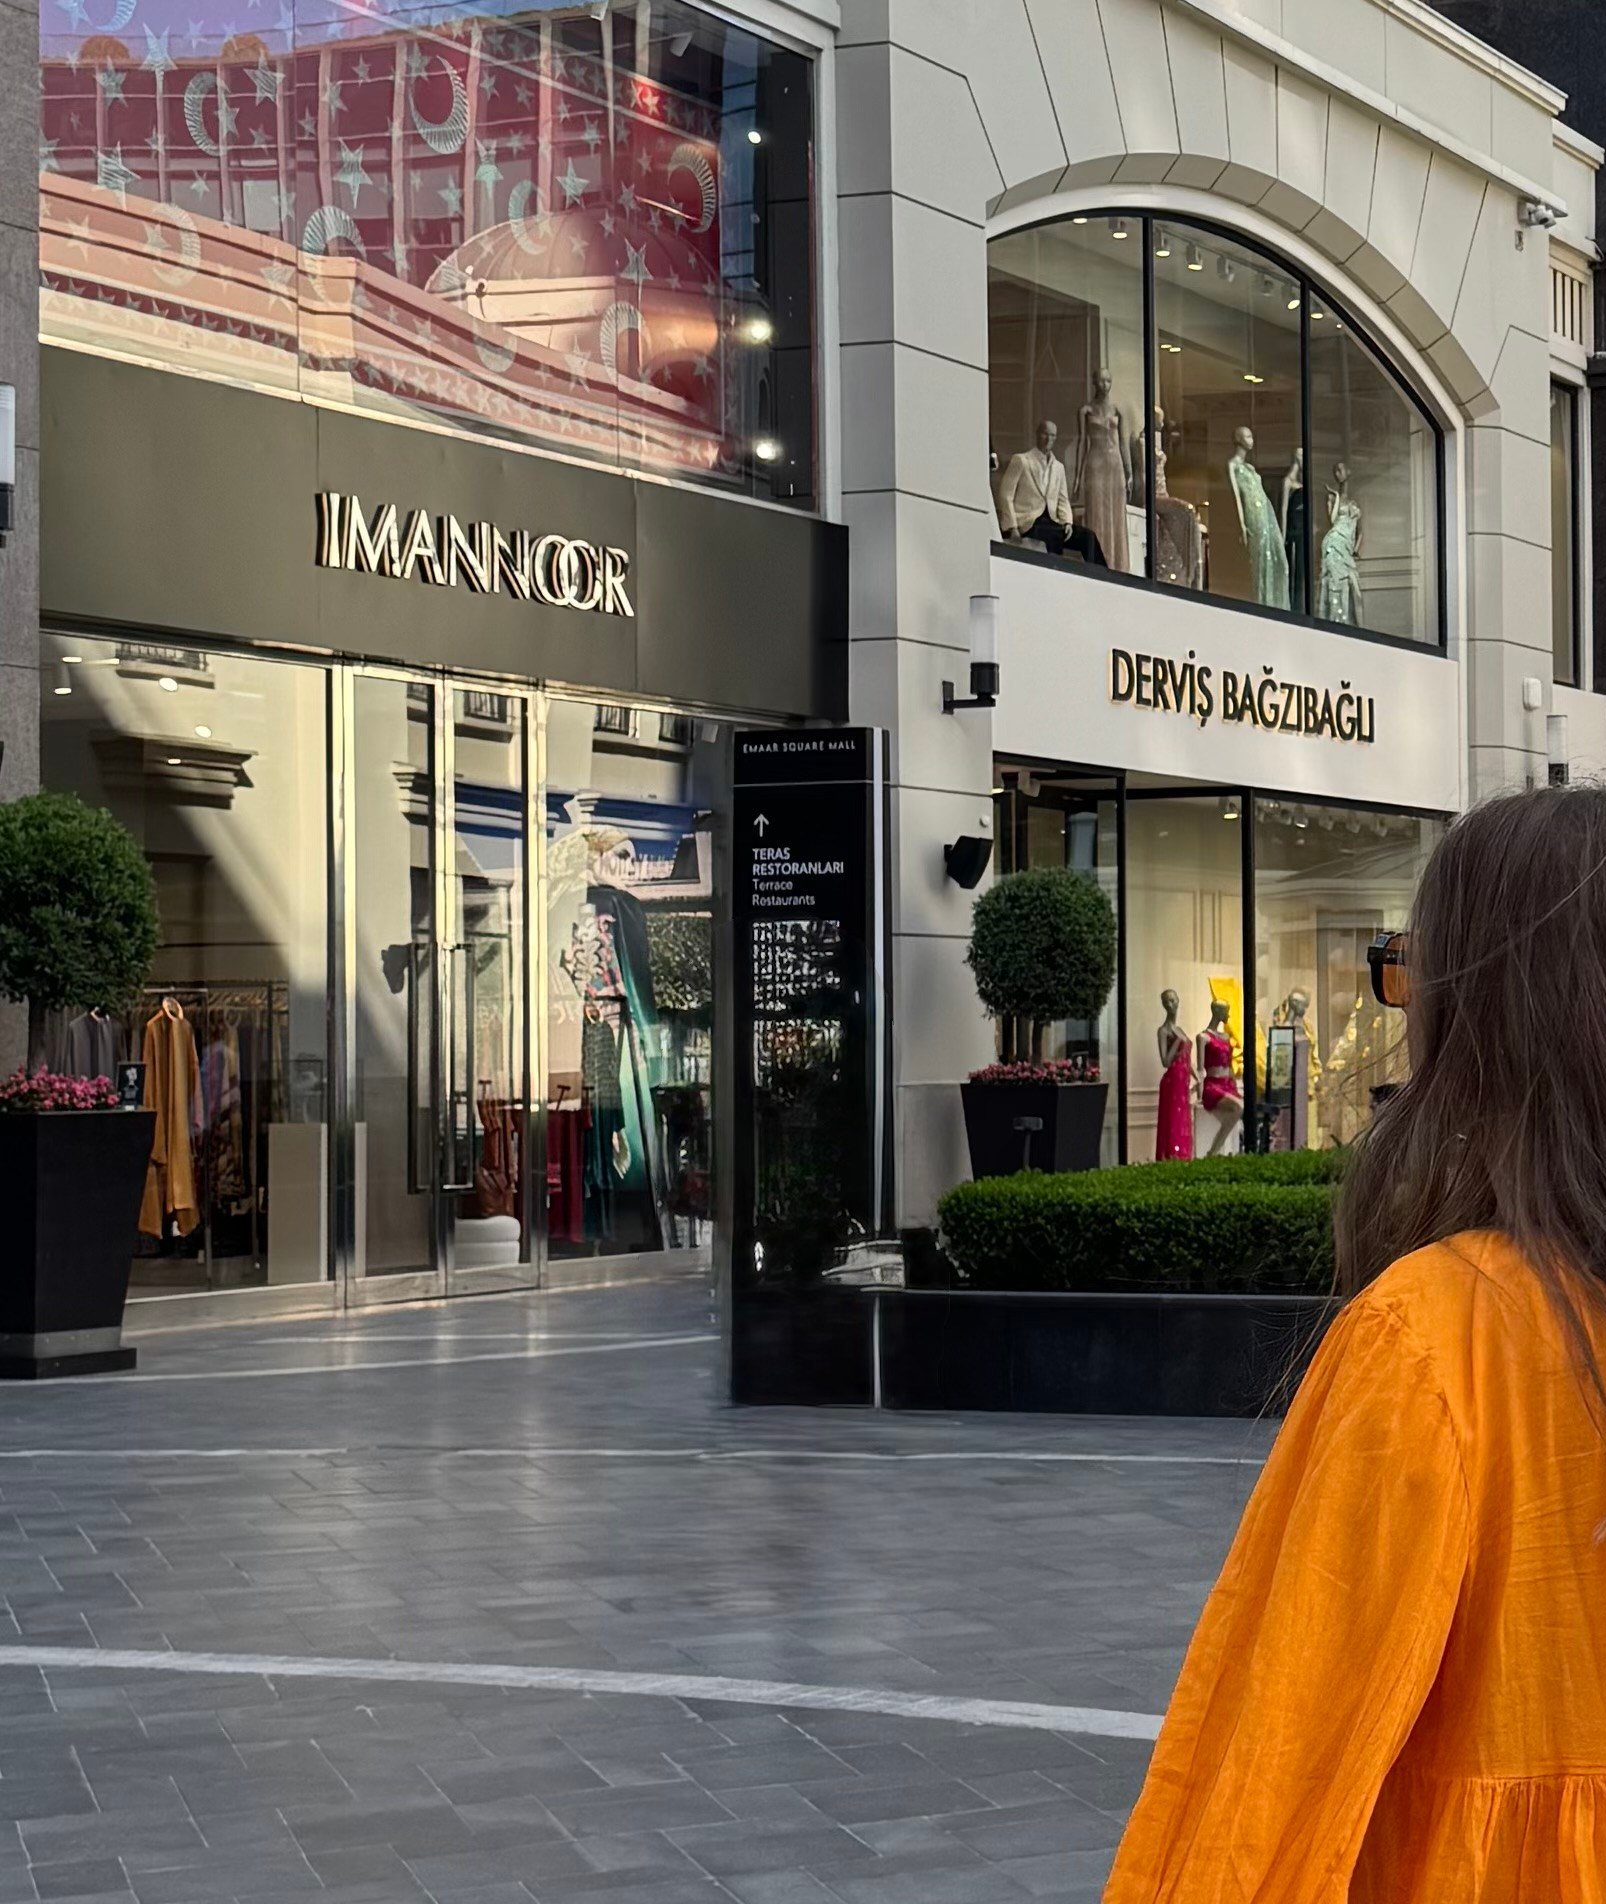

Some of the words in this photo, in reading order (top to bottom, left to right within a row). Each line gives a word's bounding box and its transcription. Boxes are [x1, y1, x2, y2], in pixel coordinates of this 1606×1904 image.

[315, 492, 635, 617] IMANNOOR
[1110, 648, 1214, 728] DERVİŞ
[1222, 664, 1375, 744] BAĞZIBAĞLI
[742, 742, 778, 754] EMAAR
[782, 740, 825, 753] SQUARE
[828, 739, 856, 751] MALL
[752, 847, 791, 861] TERAS
[752, 861, 845, 876] RESTORANLARI
[752, 878, 793, 891] Terrace
[752, 894, 816, 907] Restaurants
